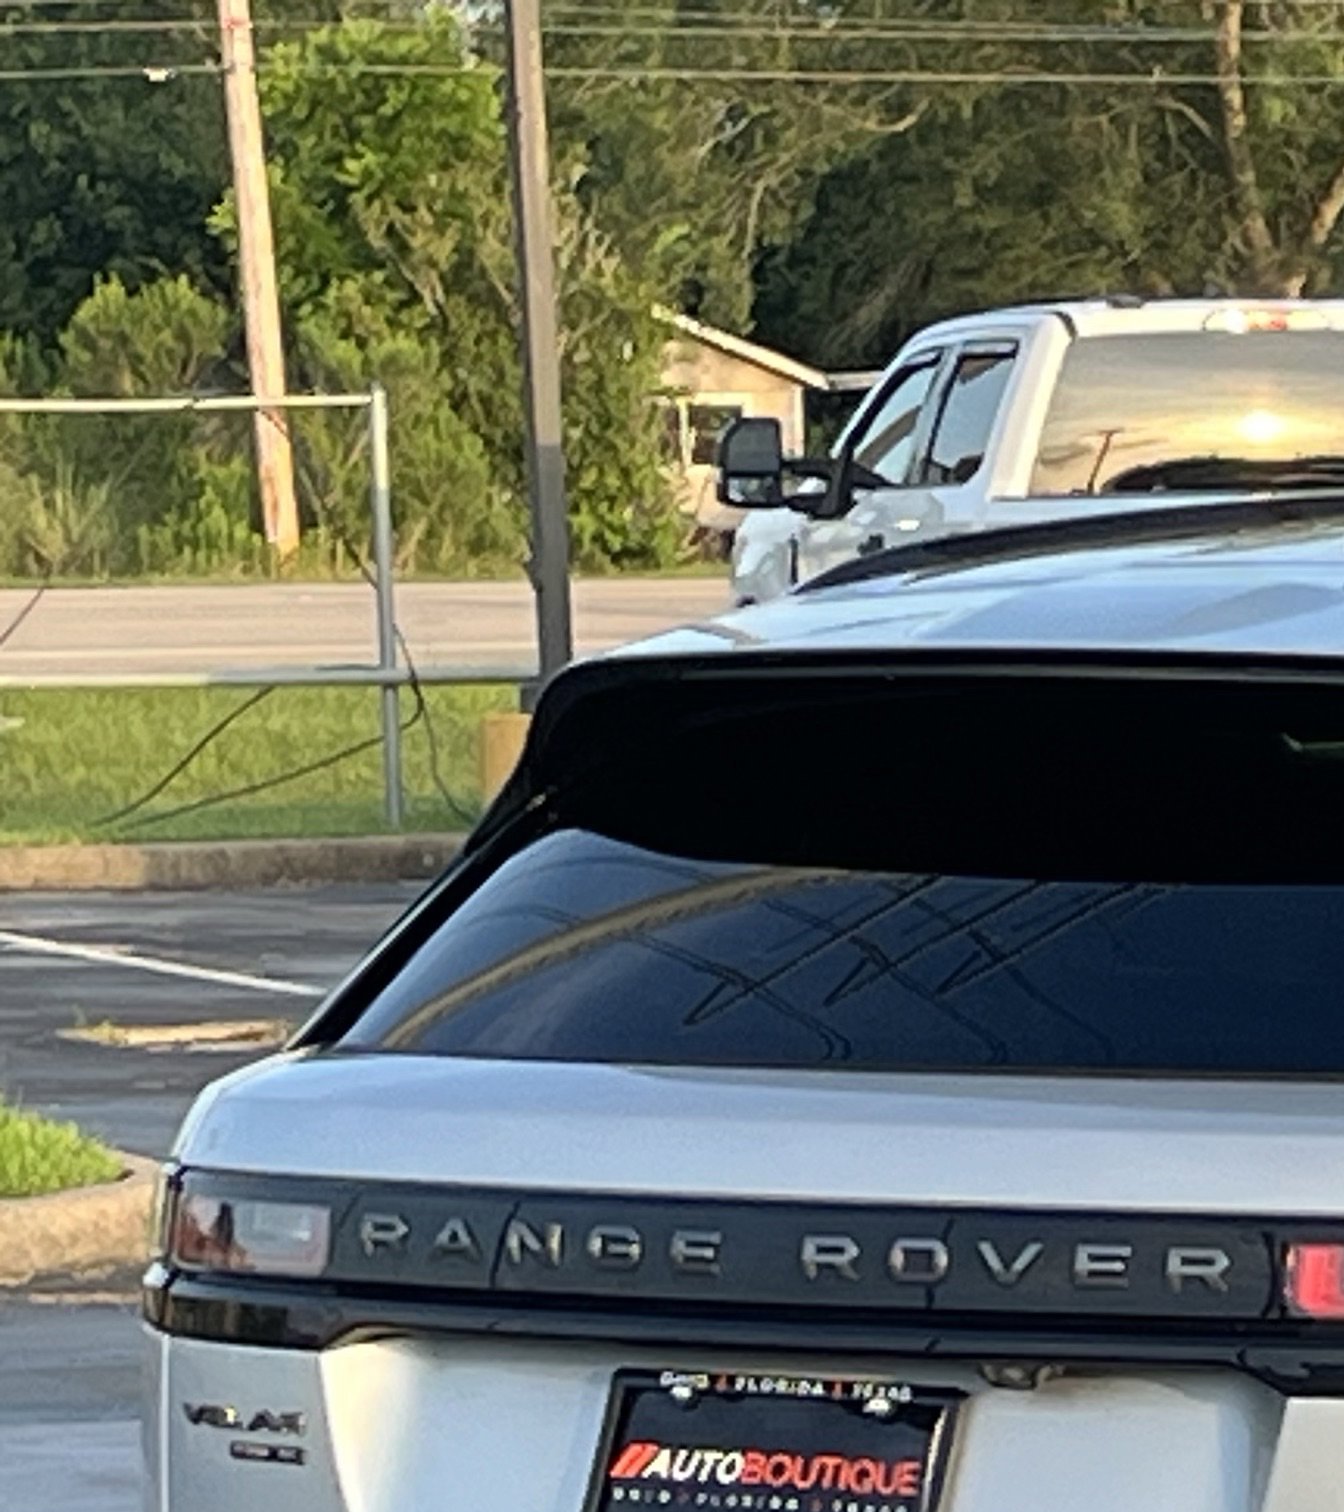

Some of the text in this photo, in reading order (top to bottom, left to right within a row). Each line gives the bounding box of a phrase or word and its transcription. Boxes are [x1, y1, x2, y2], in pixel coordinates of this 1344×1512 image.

[360, 1211, 1231, 1292] RANGE ROVER
[735, 1377, 824, 1396] FLORIDA
[642, 1448, 921, 1495] AUTOBOUTIQUE
